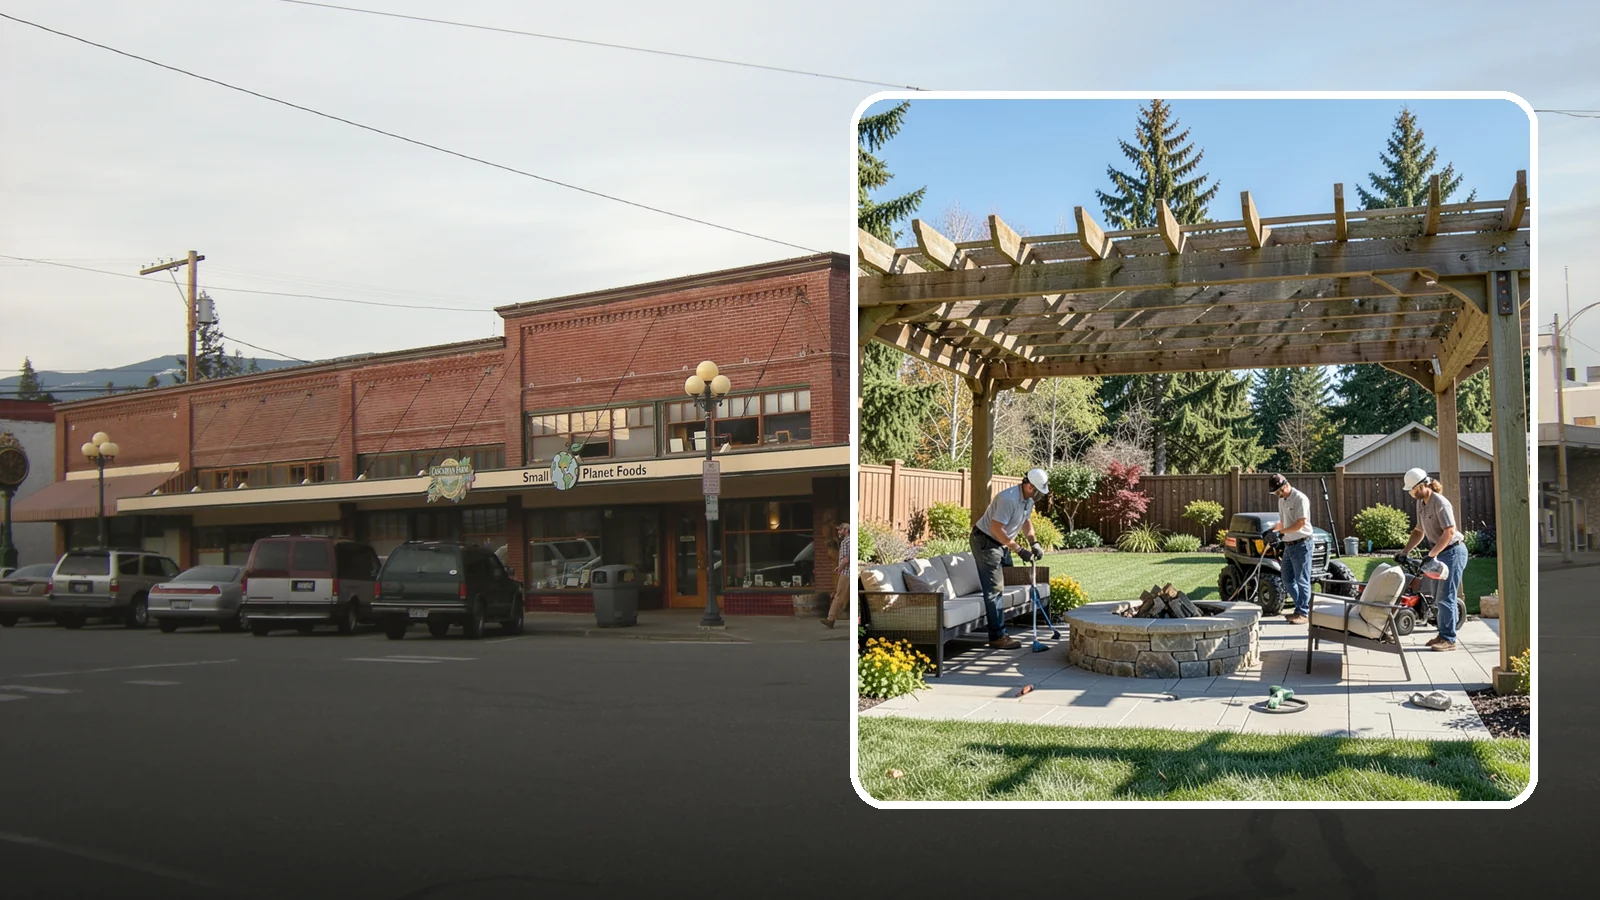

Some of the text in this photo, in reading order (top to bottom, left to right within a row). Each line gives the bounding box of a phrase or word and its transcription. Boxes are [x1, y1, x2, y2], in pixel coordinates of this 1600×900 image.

[523, 464, 647, 483] Small Planet Foods
